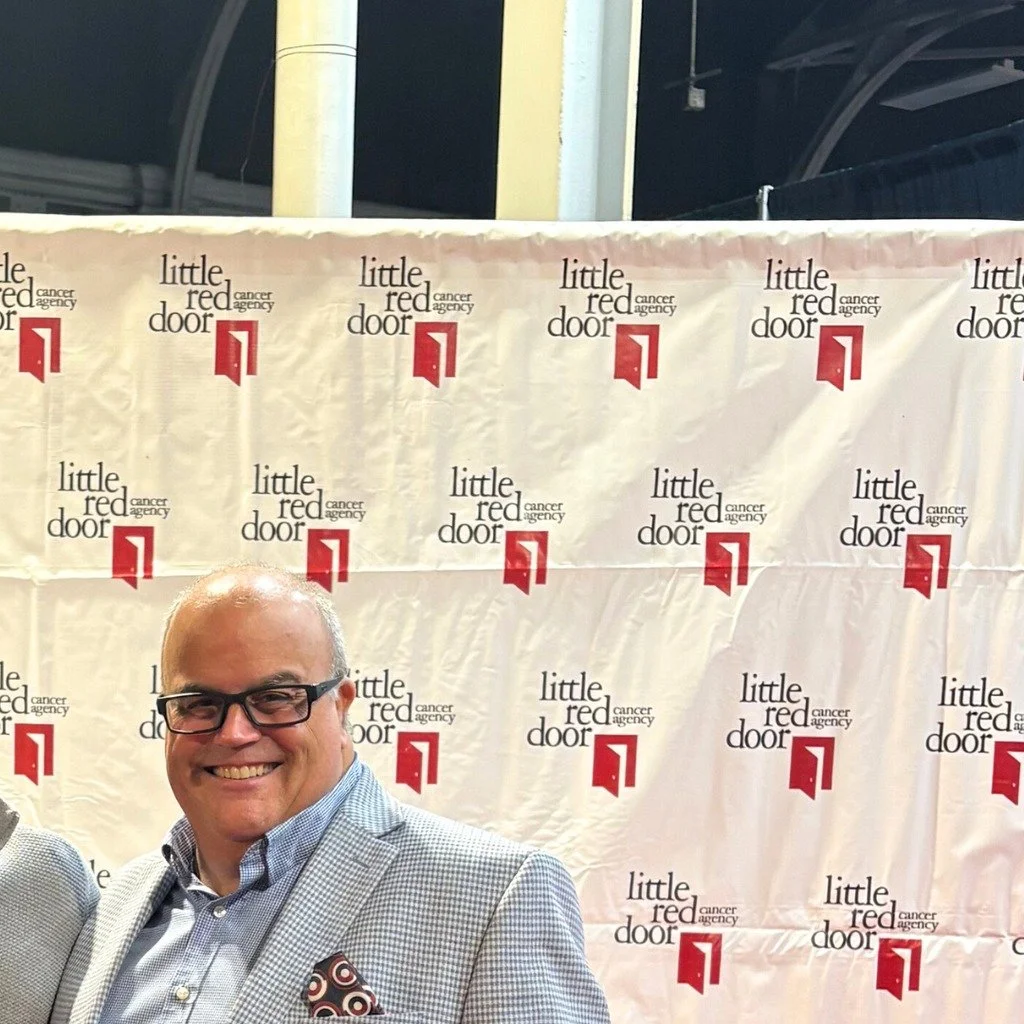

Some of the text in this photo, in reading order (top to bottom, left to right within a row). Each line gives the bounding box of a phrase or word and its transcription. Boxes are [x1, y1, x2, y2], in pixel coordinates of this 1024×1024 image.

[160, 255, 223, 286] little
[359, 256, 422, 288] little
[560, 258, 624, 290] little
[764, 258, 829, 290] little
[971, 257, 1024, 290] littl
[36, 289, 75, 298] cancer
[36, 298, 77, 311] agency
[186, 279, 232, 310] red
[233, 292, 273, 300] cancer
[233, 301, 275, 313] agency
[384, 280, 431, 312] red
[432, 302, 474, 315] agency
[433, 293, 472, 302] cancer
[585, 283, 633, 315] red
[634, 295, 675, 304] cancer
[790, 283, 837, 316] red
[839, 296, 880, 304] cancer
[996, 294, 1024, 315] re
[149, 301, 214, 333] door
[347, 303, 413, 336] door
[548, 305, 614, 338] door
[634, 305, 677, 317] agency
[752, 306, 818, 338] door
[838, 306, 882, 318] agency
[58, 461, 119, 492] little
[251, 464, 315, 496] little
[450, 466, 514, 498] little
[651, 467, 714, 499] little
[853, 468, 916, 500] little
[83, 486, 129, 517] red
[130, 498, 168, 506] cancer
[130, 508, 170, 519] agency
[278, 488, 324, 520] red
[324, 510, 366, 522] agency
[325, 500, 364, 510] cancer
[475, 491, 522, 522] red
[524, 503, 563, 511] cancer
[675, 492, 723, 523] red
[725, 504, 765, 512] cancer
[876, 494, 924, 525] red
[926, 506, 967, 514] cancer
[48, 507, 110, 538] door
[242, 510, 306, 542] door
[438, 512, 504, 544] door
[524, 512, 566, 524] agency
[638, 514, 704, 546] door
[724, 513, 767, 525] agency
[840, 515, 906, 547] door
[925, 516, 968, 528] agency
[354, 669, 405, 699] ittle
[539, 671, 602, 702] little
[740, 672, 802, 704] little
[938, 676, 1004, 708] little
[31, 697, 67, 705] cancer
[31, 706, 69, 717] agency
[368, 692, 413, 722] red
[415, 704, 454, 712] cancer
[564, 695, 611, 725] red
[613, 707, 652, 715] cancer
[764, 697, 810, 728] red
[812, 709, 850, 718] cancer
[415, 714, 456, 725] agency
[527, 716, 592, 747] door
[612, 716, 655, 728] agency
[810, 718, 852, 730] agency
[964, 701, 1012, 732] red
[352, 724, 396, 744] oor
[726, 718, 791, 749] door
[926, 722, 992, 754] door
[626, 871, 690, 902] little
[824, 875, 888, 906] little
[650, 895, 698, 924] red
[698, 916, 739, 927] agency
[699, 906, 737, 914] cancer
[849, 900, 896, 930] red
[898, 911, 937, 920] cancer
[614, 915, 678, 945] door
[811, 920, 877, 950] door
[897, 920, 939, 932] agency
